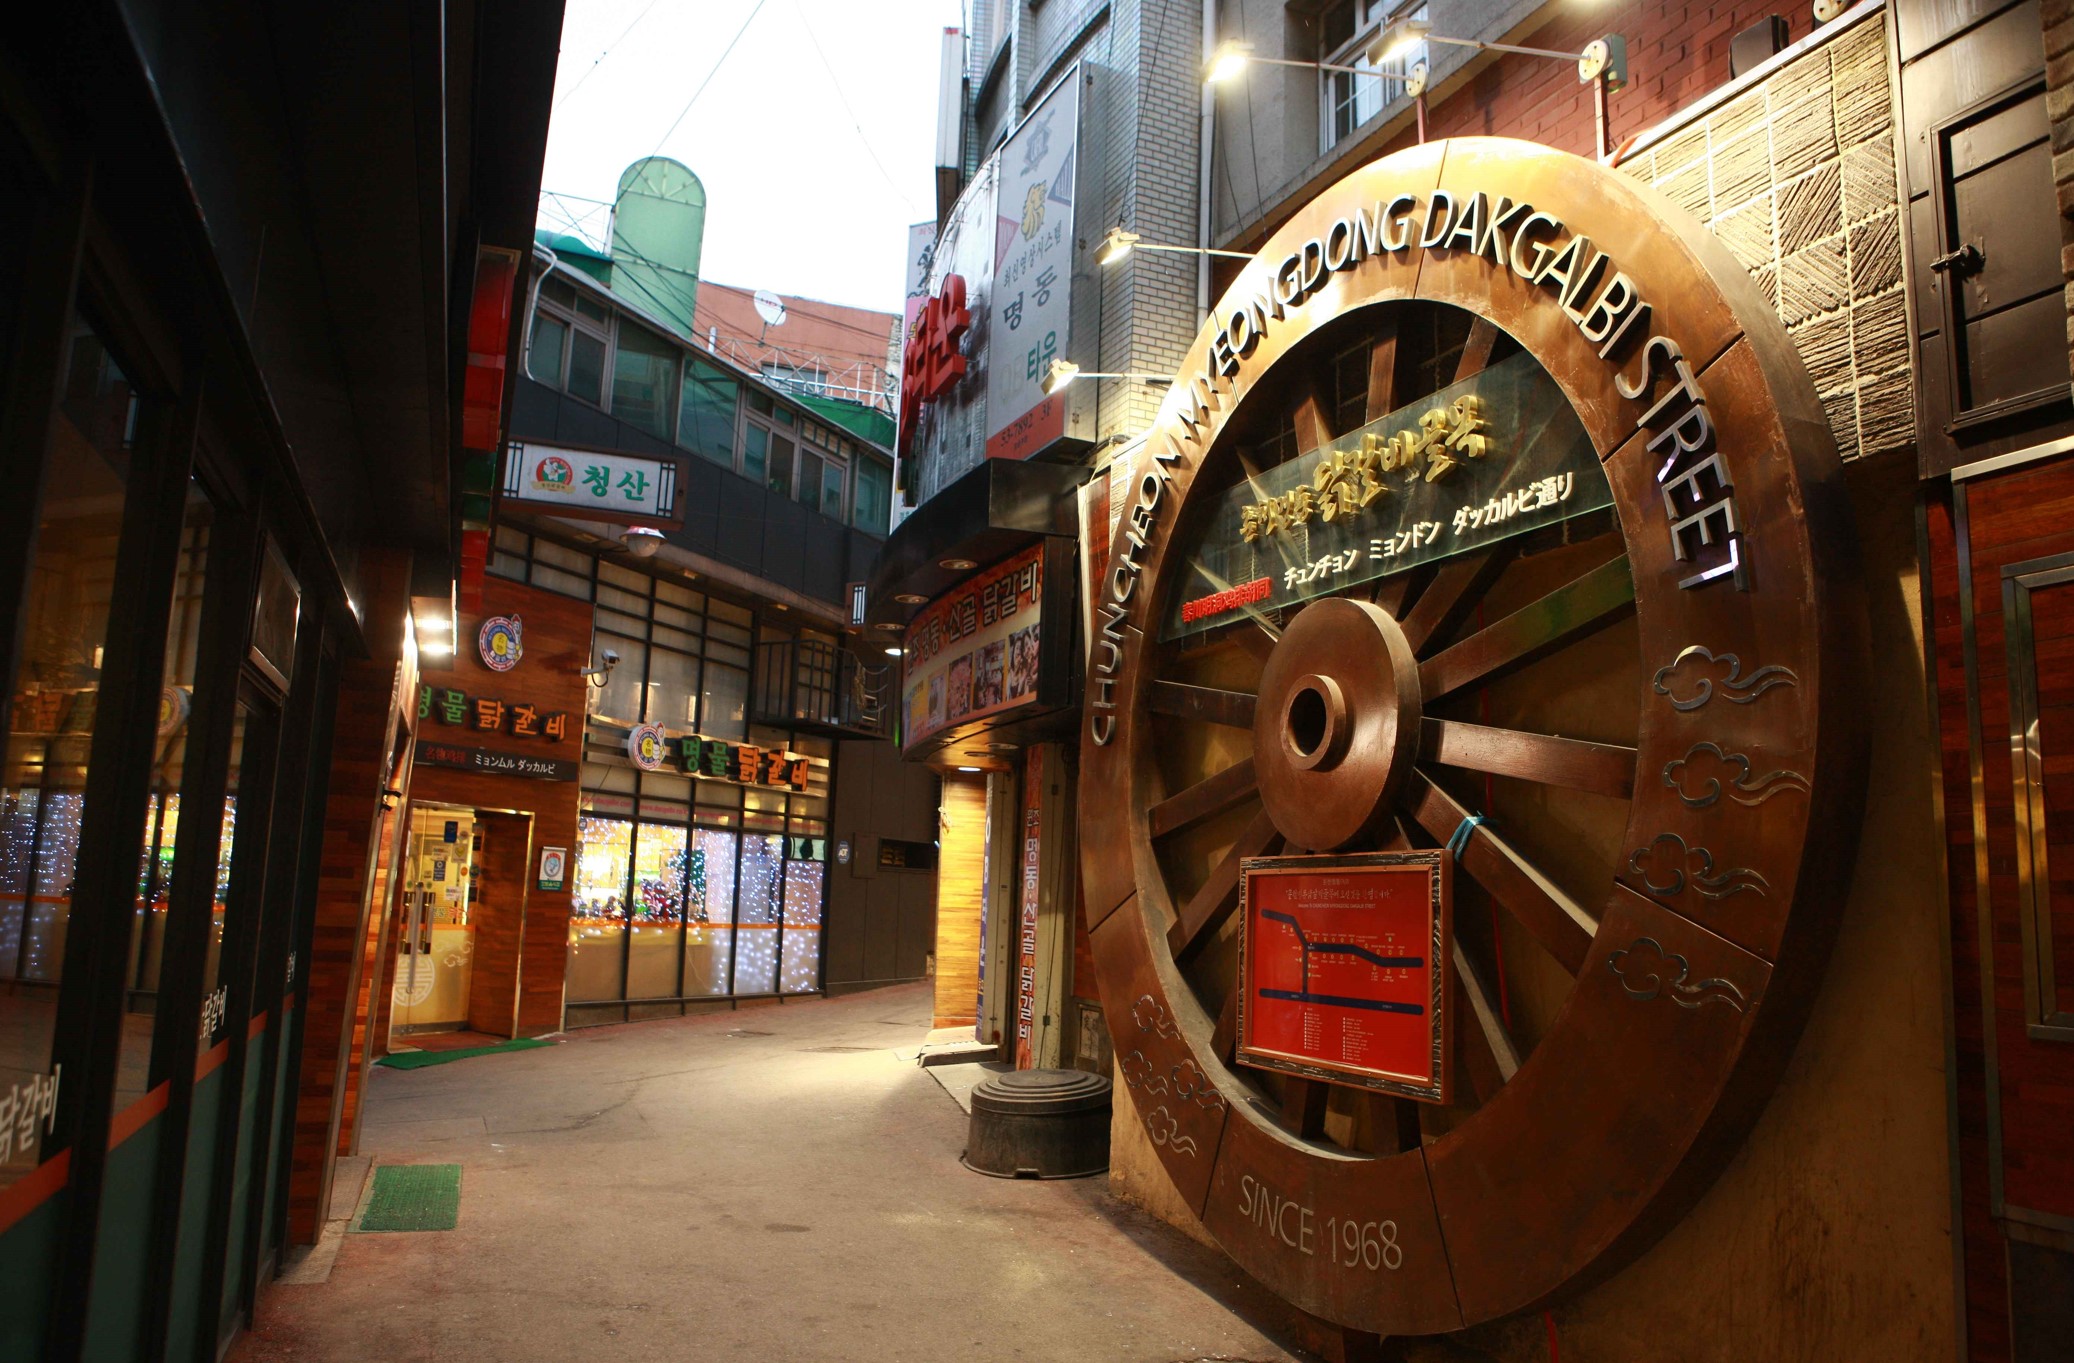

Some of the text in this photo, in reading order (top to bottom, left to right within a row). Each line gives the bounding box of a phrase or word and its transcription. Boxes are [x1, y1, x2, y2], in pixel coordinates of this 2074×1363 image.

[581, 465, 650, 502] 청산
[1091, 188, 1749, 746] CHUNCHEON MYEONGDONG DAKGALBI STREET
[1284, 471, 1574, 590] チュンチョン ミョンドン ダッカルビ通り
[982, 561, 1038, 628] 닭갈비
[1238, 1174, 1403, 1271] SINCE 1968
